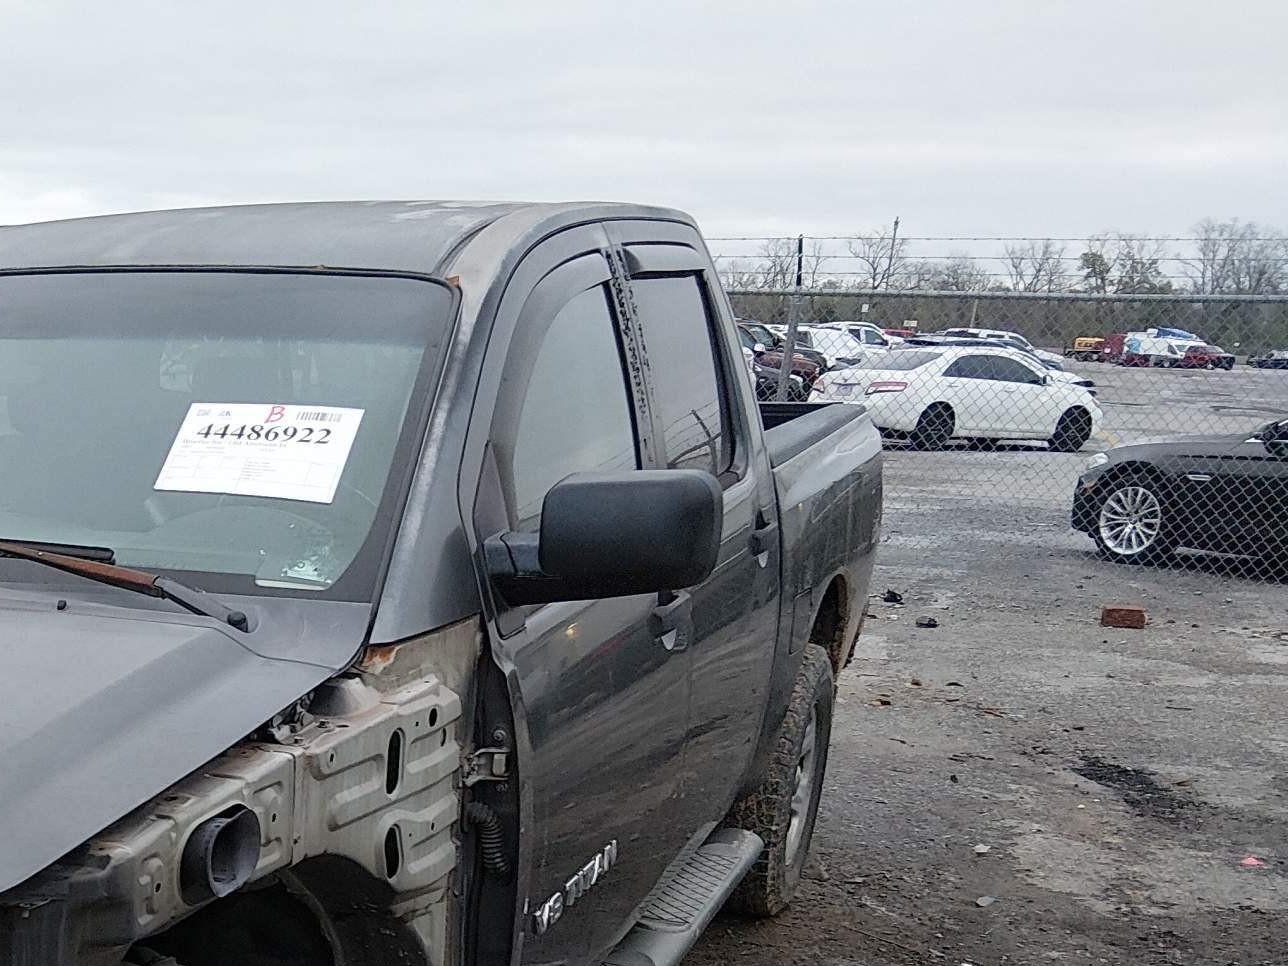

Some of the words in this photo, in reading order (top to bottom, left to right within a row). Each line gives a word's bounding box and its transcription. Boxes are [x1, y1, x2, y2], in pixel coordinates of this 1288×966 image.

[263, 404, 287, 424] B
[196, 422, 332, 445] 44486922
[533, 892, 563, 935] V8
[565, 839, 618, 906] TITAN
